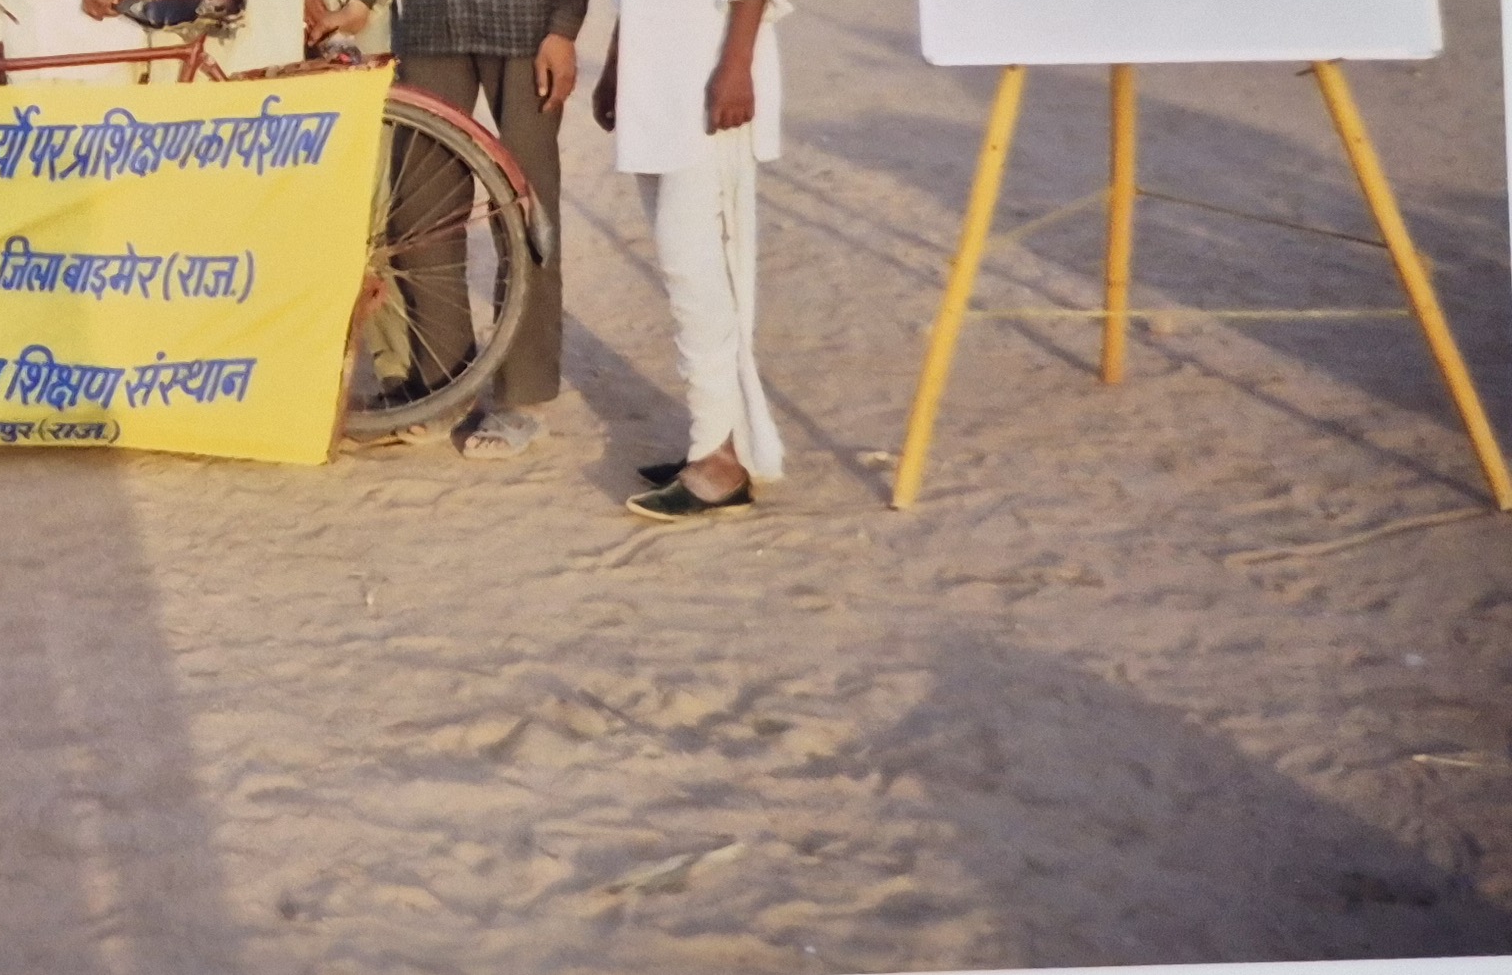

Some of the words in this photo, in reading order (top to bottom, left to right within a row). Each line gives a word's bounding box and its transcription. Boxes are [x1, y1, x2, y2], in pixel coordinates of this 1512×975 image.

[29, 124, 78, 182] पर
[58, 107, 206, 181] प्रशिक्षण
[194, 94, 341, 176] कार्यशाला
[4, 344, 126, 411] शिक्षण
[125, 351, 258, 408] संस्थान
